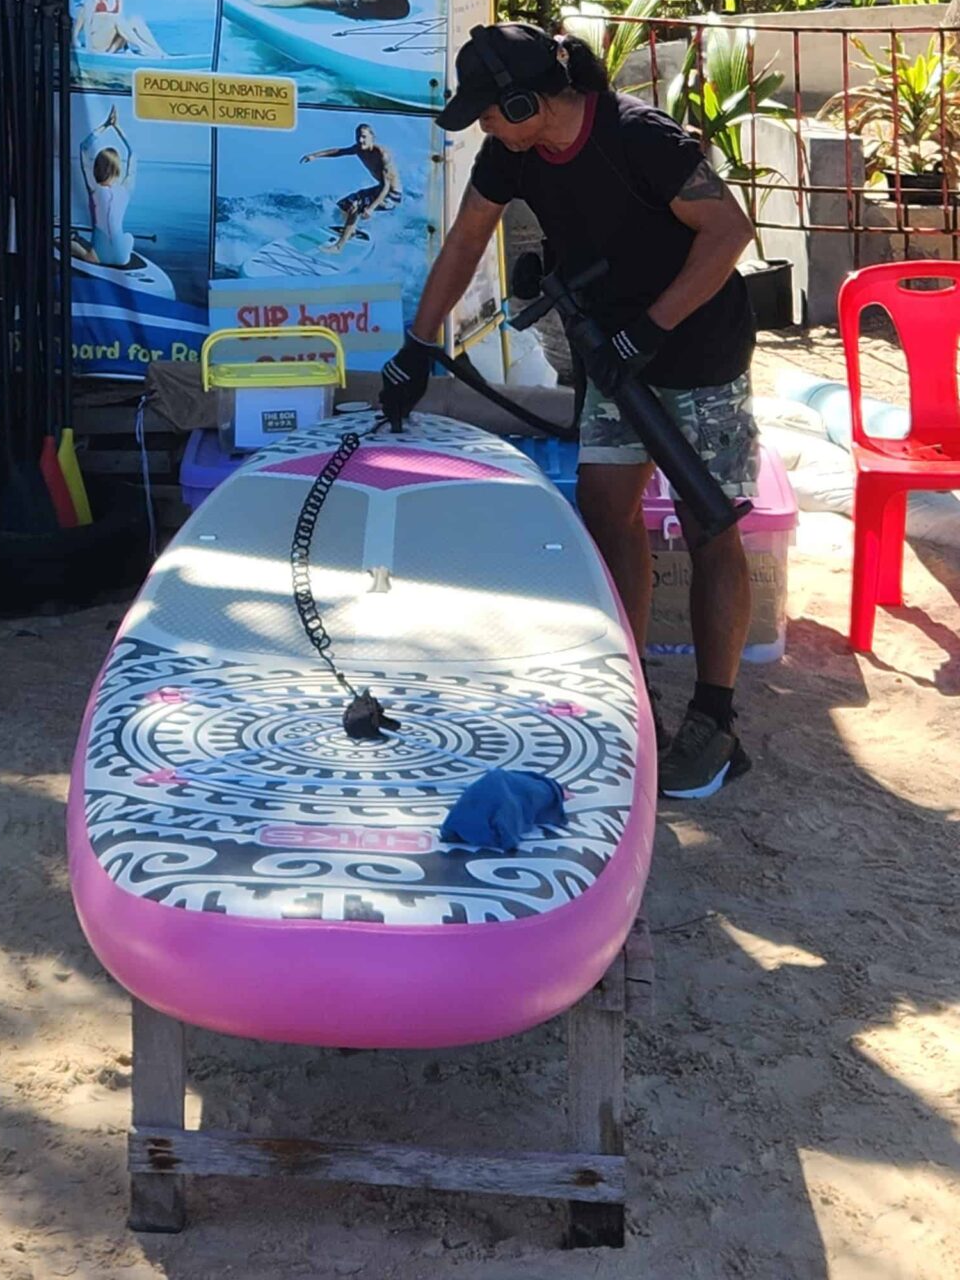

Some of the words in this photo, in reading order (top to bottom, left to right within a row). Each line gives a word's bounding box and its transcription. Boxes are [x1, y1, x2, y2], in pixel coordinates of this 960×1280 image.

[144, 78, 209, 94] PADDLING
[218, 82, 288, 99] SUNBATHING
[168, 102, 209, 116] YOGA
[218, 106, 277, 121] SURFING
[236, 305, 289, 340] SUP
[128, 343, 164, 363] for
